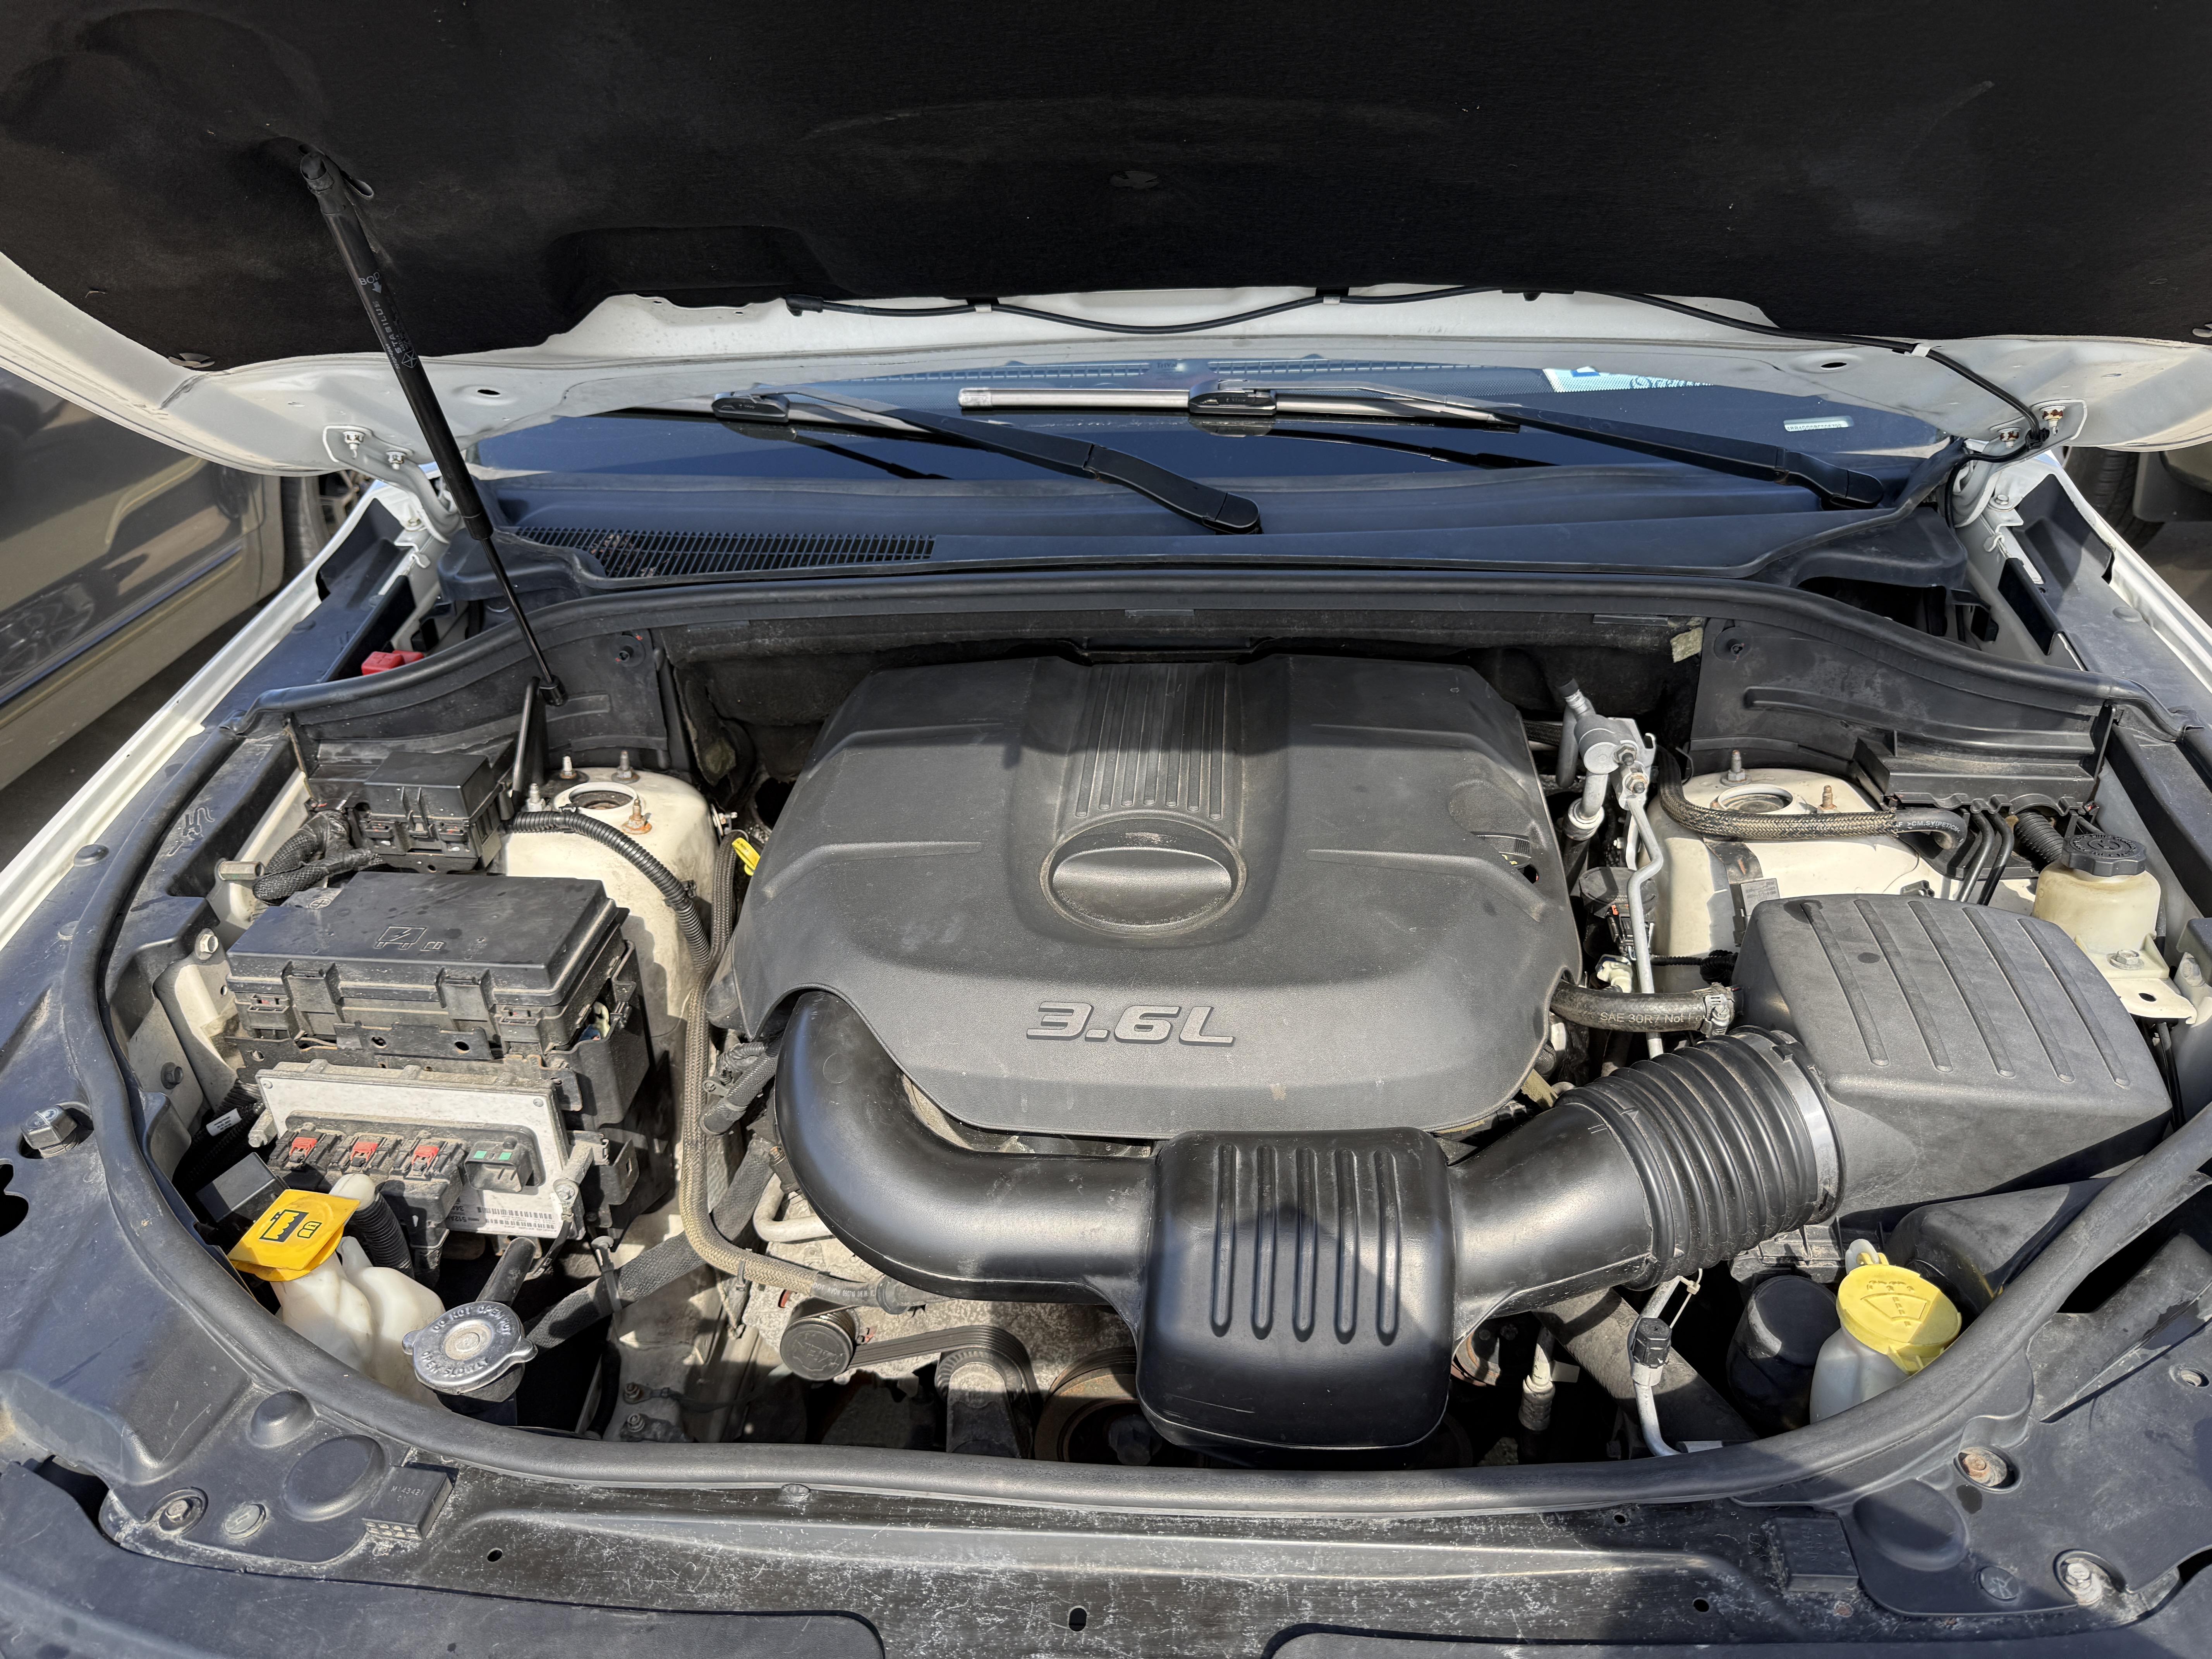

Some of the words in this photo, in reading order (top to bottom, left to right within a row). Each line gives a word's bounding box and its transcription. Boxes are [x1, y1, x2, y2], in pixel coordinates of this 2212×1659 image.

[359, 270, 380, 285] BOD
[372, 301, 402, 354] STABILUS
[1026, 1001, 1236, 1048] 3.6L
[1600, 1012, 1625, 1022] SAE
[1628, 1013, 1661, 1024] 30R7
[1665, 1013, 1685, 1023] Not
[1688, 1012, 1705, 1022] Fo
[812, 1282, 826, 1290] DOT
[827, 1286, 841, 1296] AVON
[433, 1320, 445, 1333] DO
[451, 1307, 472, 1320] NOT
[479, 1305, 505, 1320] OPEN
[498, 1317, 512, 1336] HOT
[421, 1351, 439, 1374] OPEN
[443, 1358, 488, 1377] SLOWLY
